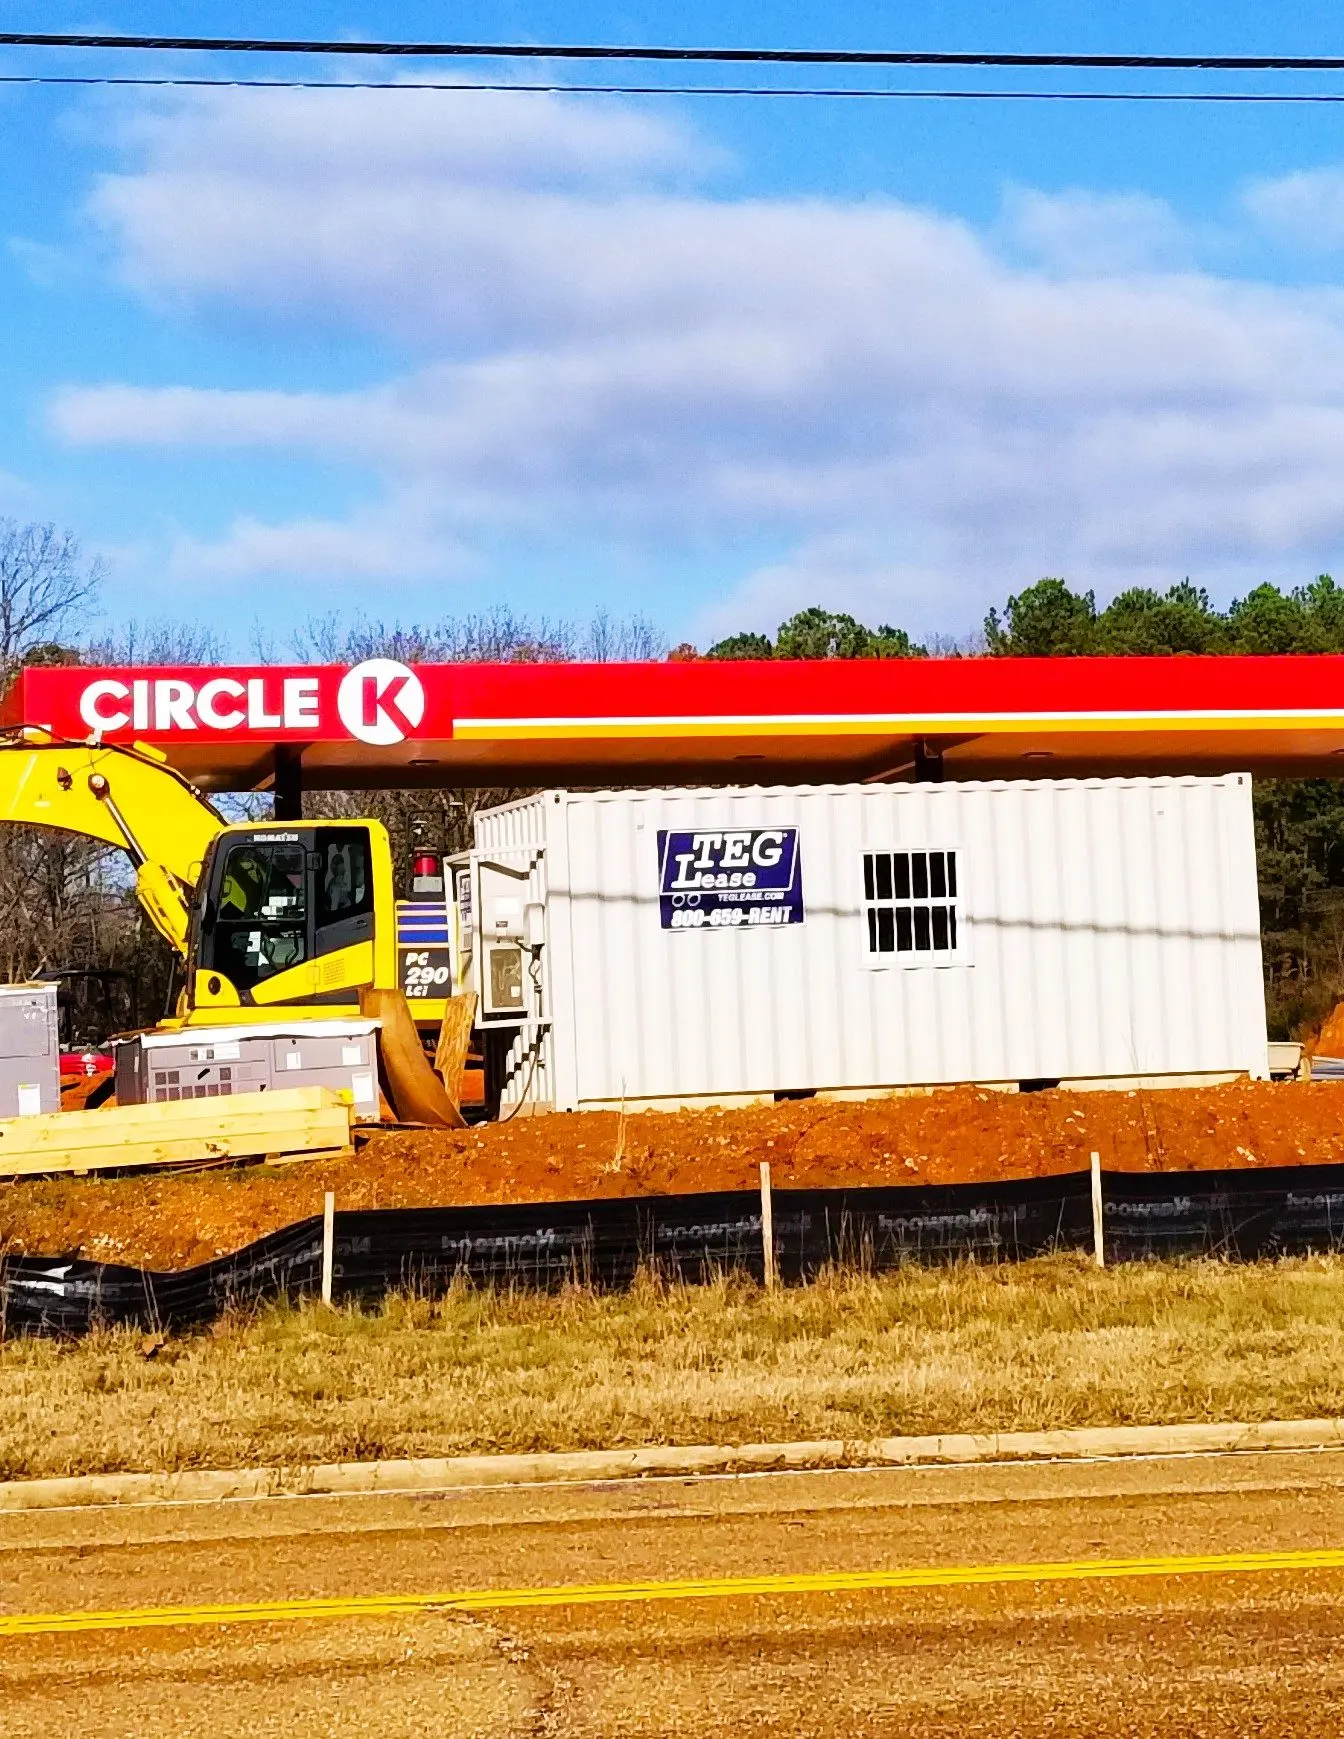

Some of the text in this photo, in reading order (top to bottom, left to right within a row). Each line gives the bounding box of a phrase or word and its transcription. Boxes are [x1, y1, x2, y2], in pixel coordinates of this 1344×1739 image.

[79, 676, 415, 735] CIRCLE K
[693, 831, 783, 869] TEG
[671, 854, 756, 889] Lease
[718, 892, 784, 902] TEGLEASE.COM
[671, 906, 793, 927] 800-659-RENT
[405, 952, 429, 967] PC
[405, 967, 449, 985] 290
